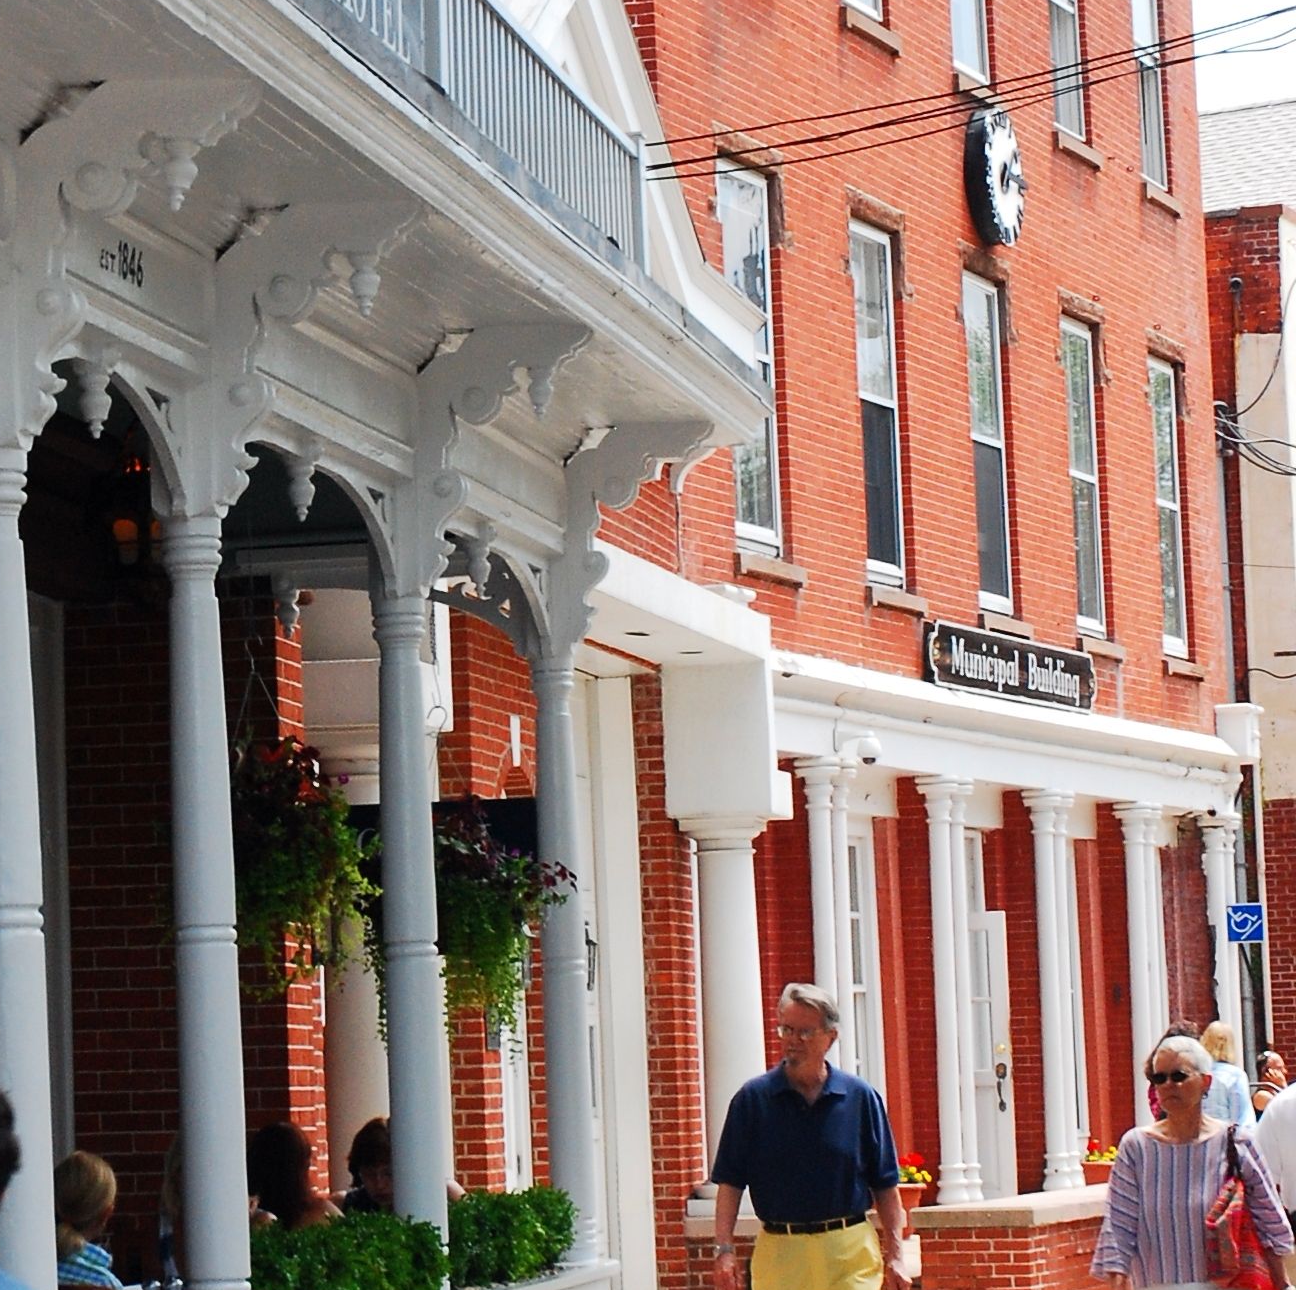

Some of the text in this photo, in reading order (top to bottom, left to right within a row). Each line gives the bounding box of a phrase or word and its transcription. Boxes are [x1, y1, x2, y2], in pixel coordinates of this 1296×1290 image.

[118, 240, 144, 288] 1846
[951, 635, 1080, 706] Municipal Building
